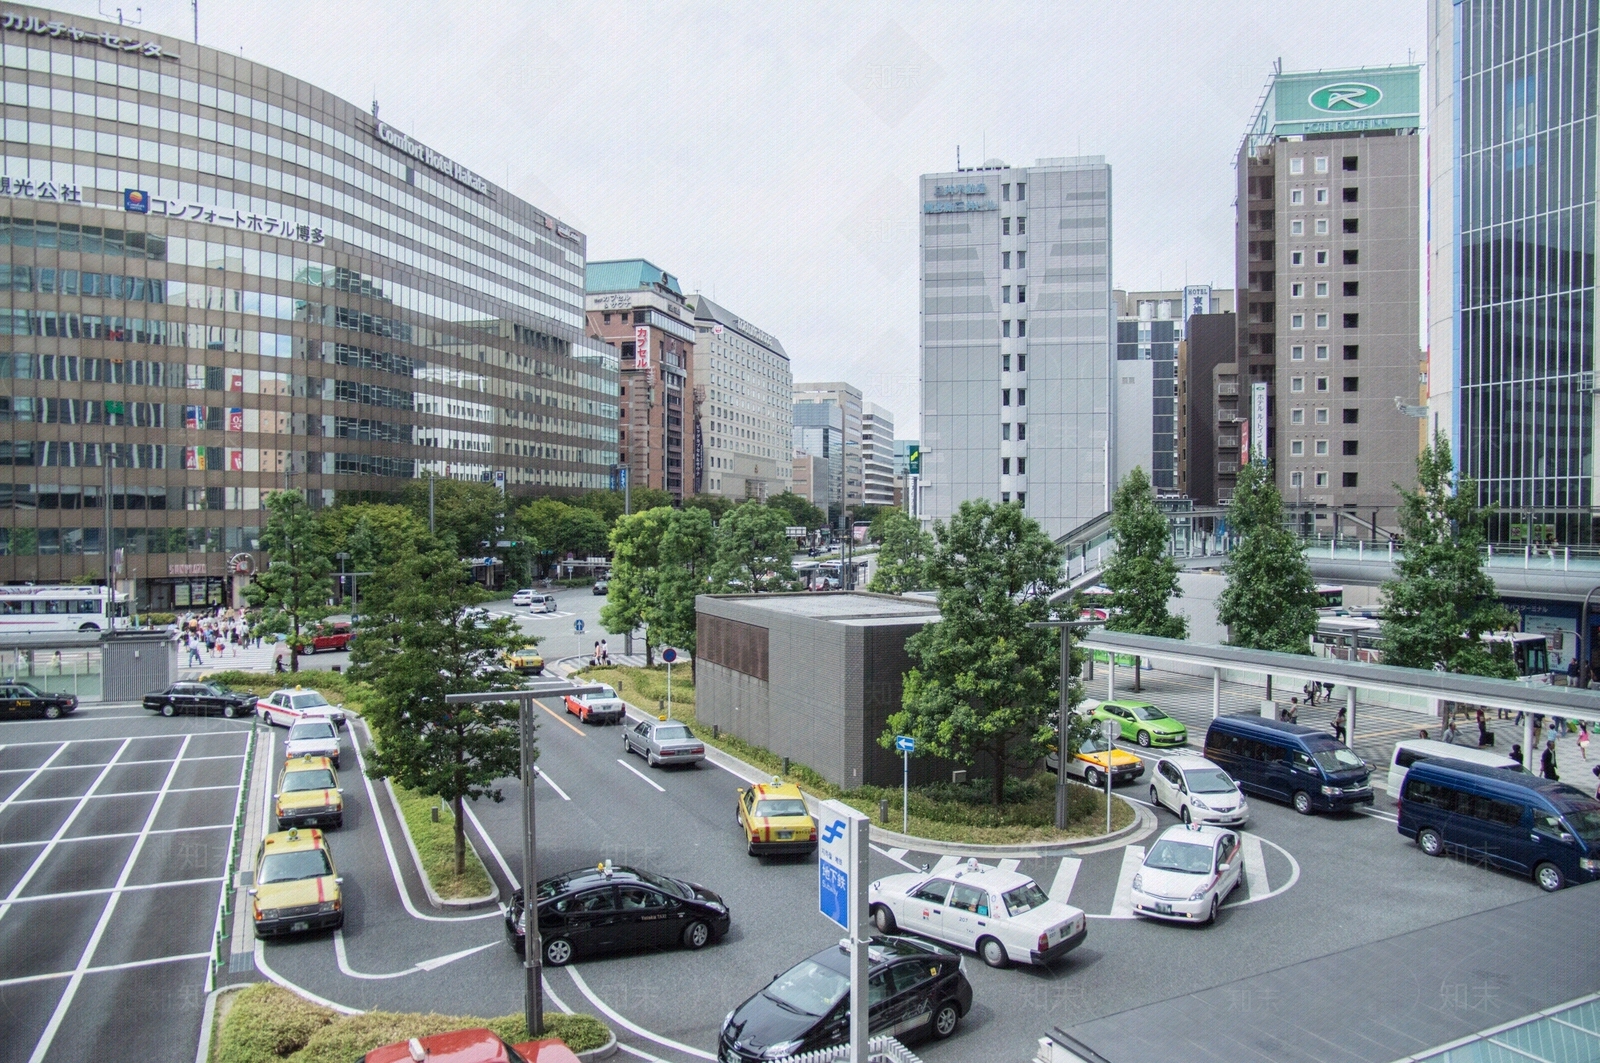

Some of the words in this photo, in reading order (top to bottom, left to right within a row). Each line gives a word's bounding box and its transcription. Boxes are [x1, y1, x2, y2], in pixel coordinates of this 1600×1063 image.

[2, 12, 181, 59] カルチャーセンター
[1303, 123, 1333, 133] HOTEL
[378, 122, 424, 161] Comfort
[426, 147, 453, 176] Hotel
[454, 163, 487, 195] Hakata
[152, 199, 325, 244] コンフォートホテル博多
[637, 328, 648, 368] カプセル
[822, 863, 846, 891] 地下鉄
